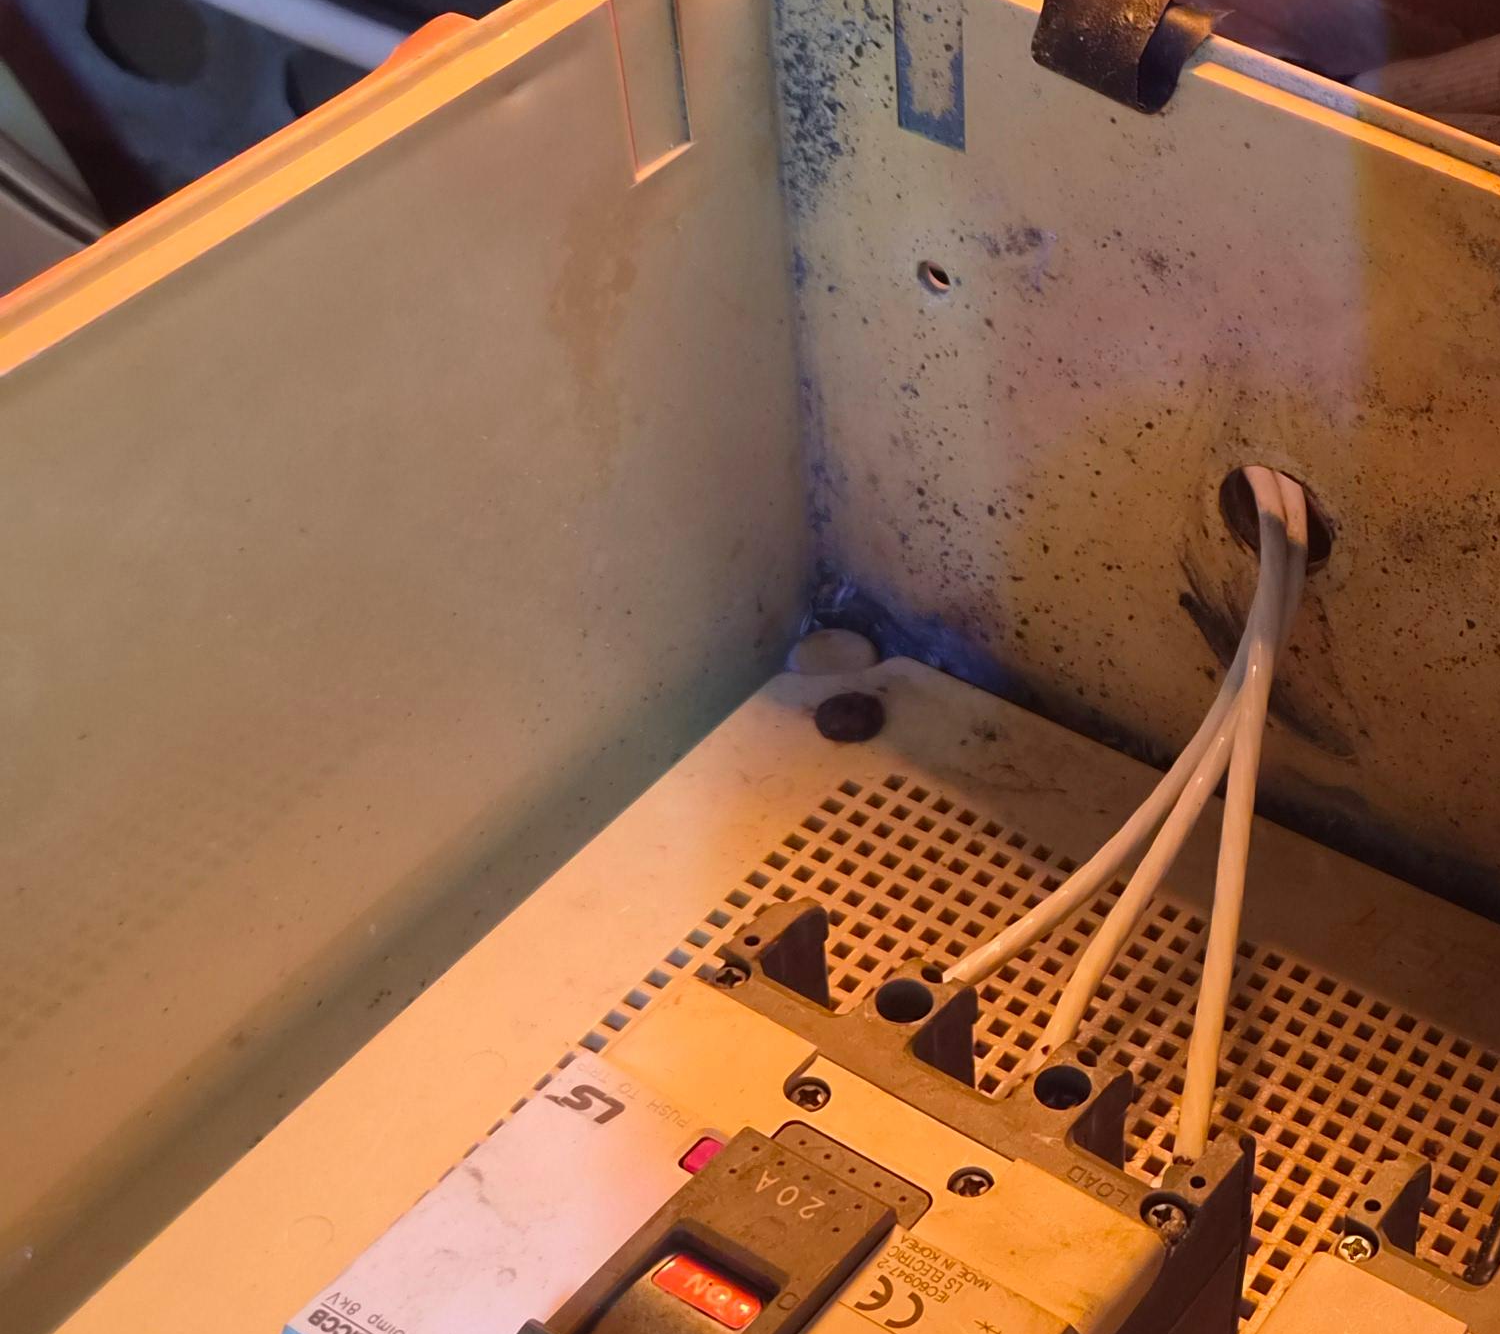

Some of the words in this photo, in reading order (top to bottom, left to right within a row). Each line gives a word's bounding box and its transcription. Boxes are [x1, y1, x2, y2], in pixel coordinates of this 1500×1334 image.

[556, 1081, 625, 1125] LS
[754, 1169, 826, 1220] 20A
[1064, 1163, 1129, 1208] LOAD
[886, 1245, 946, 1284] ELECTRIC
[900, 1234, 942, 1263] KOREA
[940, 1257, 957, 1271] IN
[682, 1270, 731, 1307] ON
[876, 1259, 951, 1304] IEC60947-2
[943, 1276, 965, 1295] LS
[956, 1266, 993, 1292] MADE
[325, 1291, 362, 1317] 8kV
